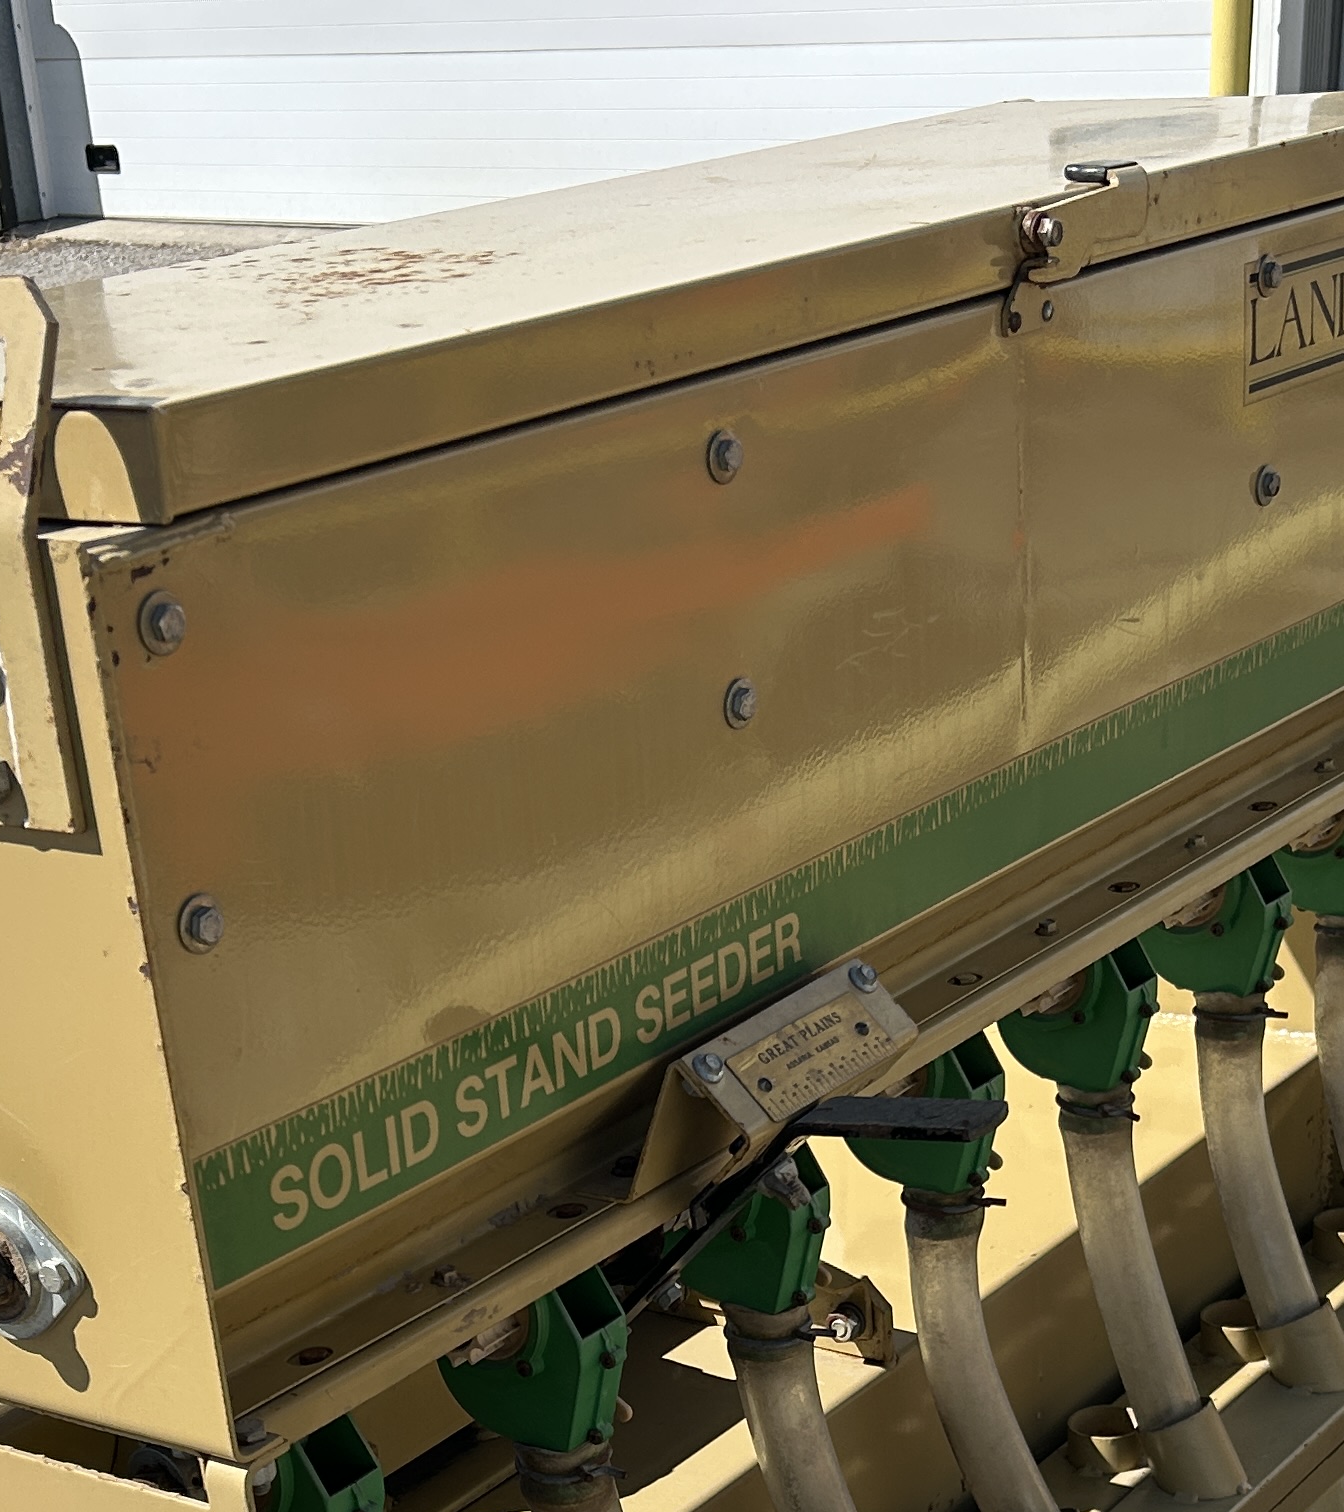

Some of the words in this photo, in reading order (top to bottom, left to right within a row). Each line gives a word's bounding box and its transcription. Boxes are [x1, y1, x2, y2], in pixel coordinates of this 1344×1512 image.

[269, 1098, 440, 1232] SOLID
[456, 1006, 623, 1139] STAND
[634, 911, 803, 1045] SEEDER
[757, 1034, 800, 1065] GREAT
[800, 1011, 843, 1042] PLAINS
